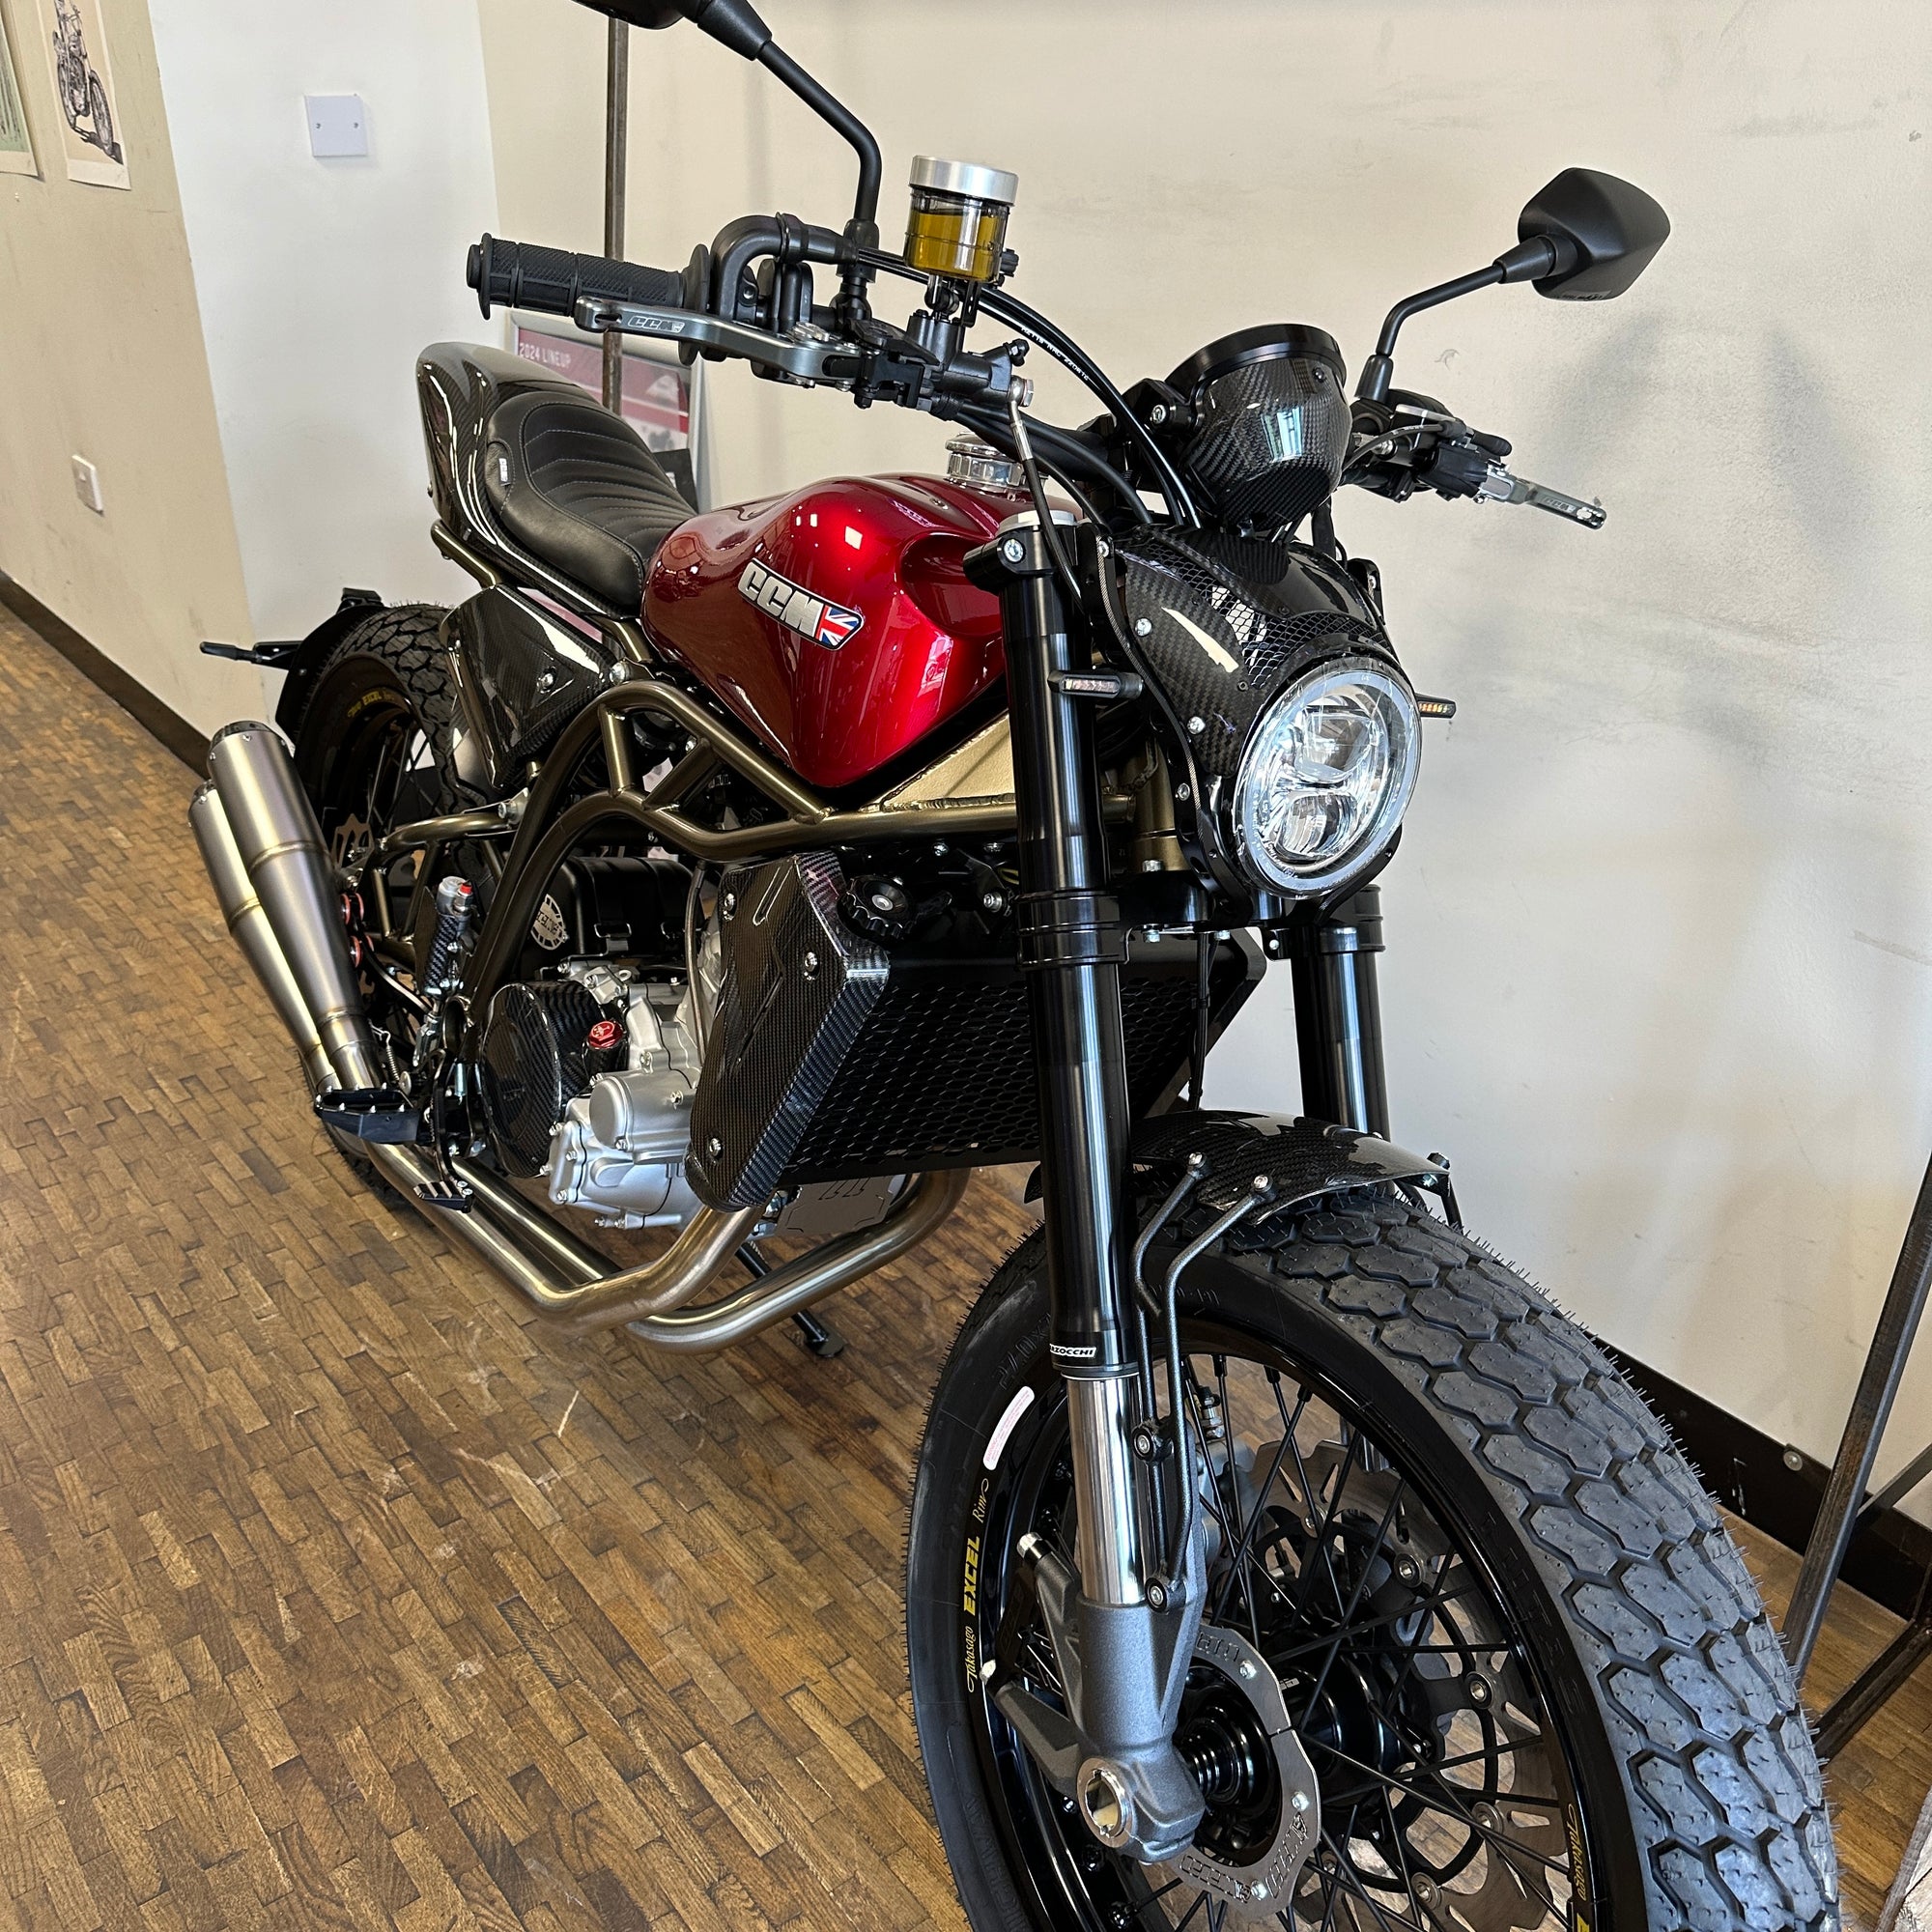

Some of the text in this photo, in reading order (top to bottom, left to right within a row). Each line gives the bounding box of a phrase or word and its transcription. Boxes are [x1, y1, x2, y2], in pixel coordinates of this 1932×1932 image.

[519, 342, 571, 368] 2024 LINEUP
[737, 561, 824, 638] CCM
[963, 1478, 989, 1692] Takasago EXCEL Rim
[1567, 1804, 1587, 1901] Takasago
